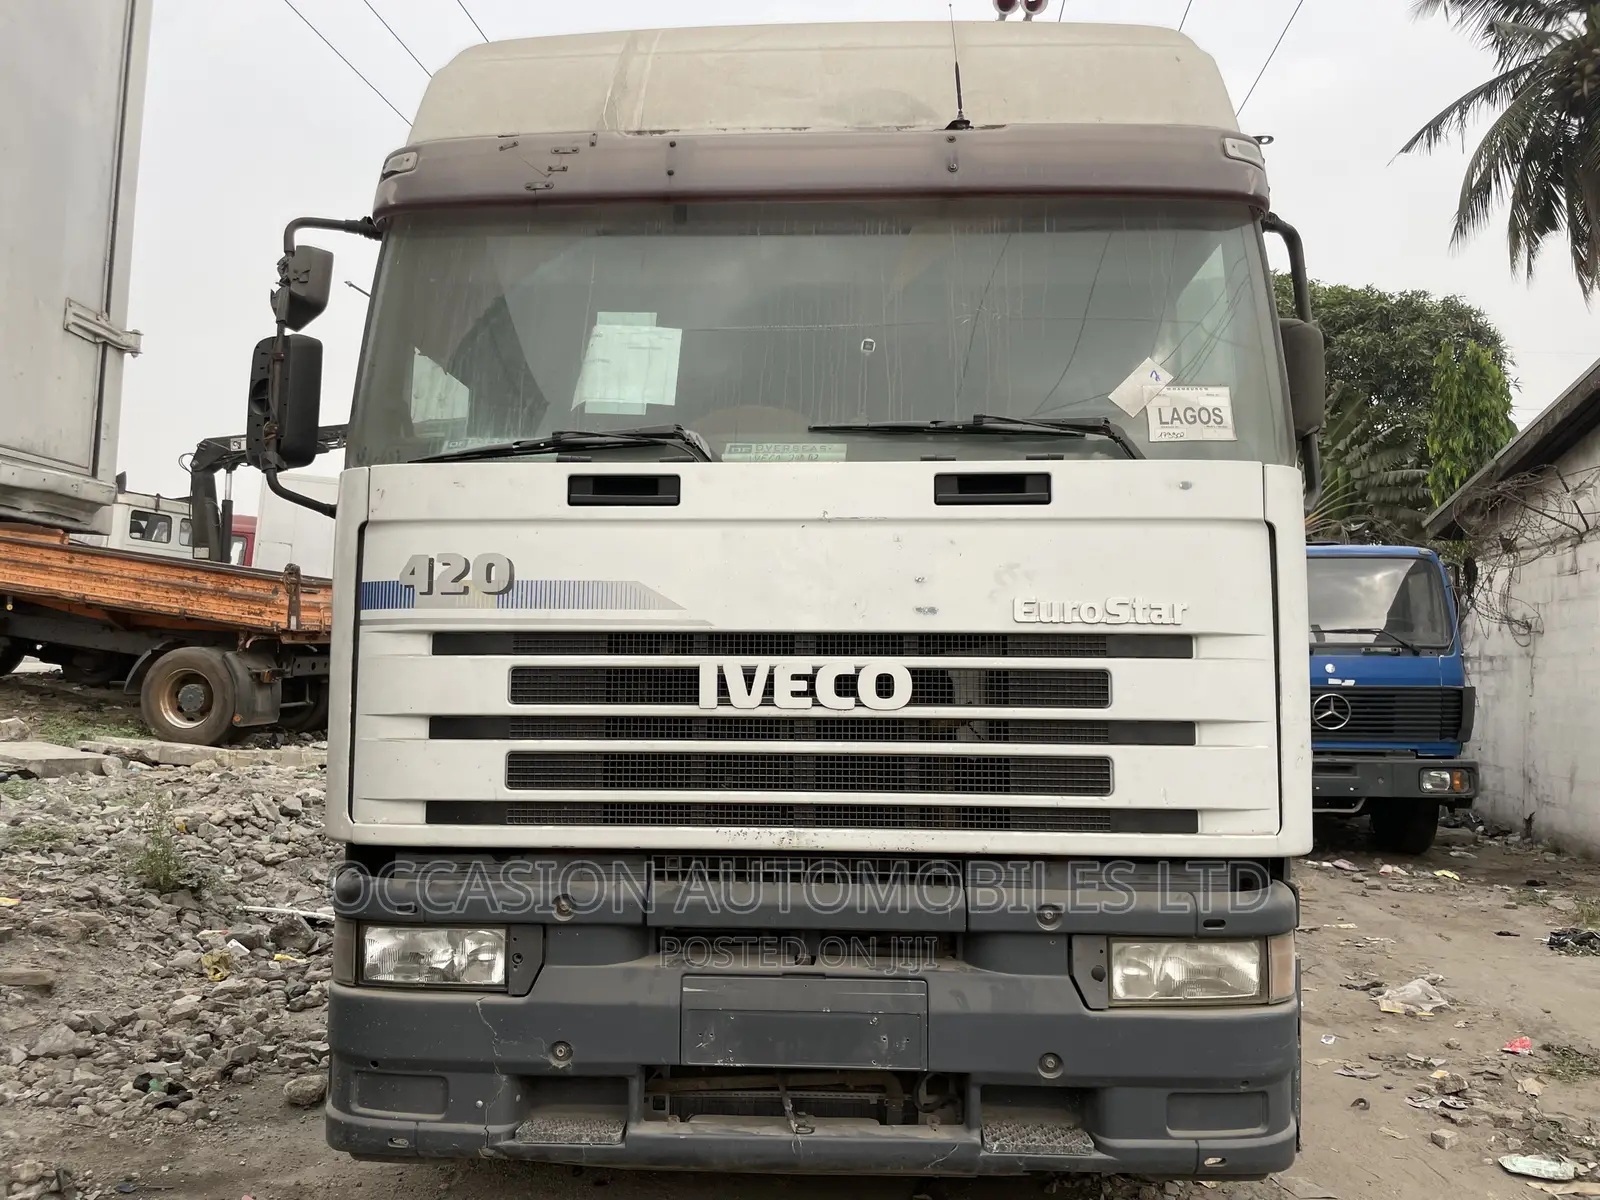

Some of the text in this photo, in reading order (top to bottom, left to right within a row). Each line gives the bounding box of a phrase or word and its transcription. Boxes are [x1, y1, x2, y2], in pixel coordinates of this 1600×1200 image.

[1157, 406, 1224, 425] LAGOS
[399, 552, 515, 595] 420
[1013, 596, 1188, 625] EuroStar
[699, 662, 912, 710] IVECO
